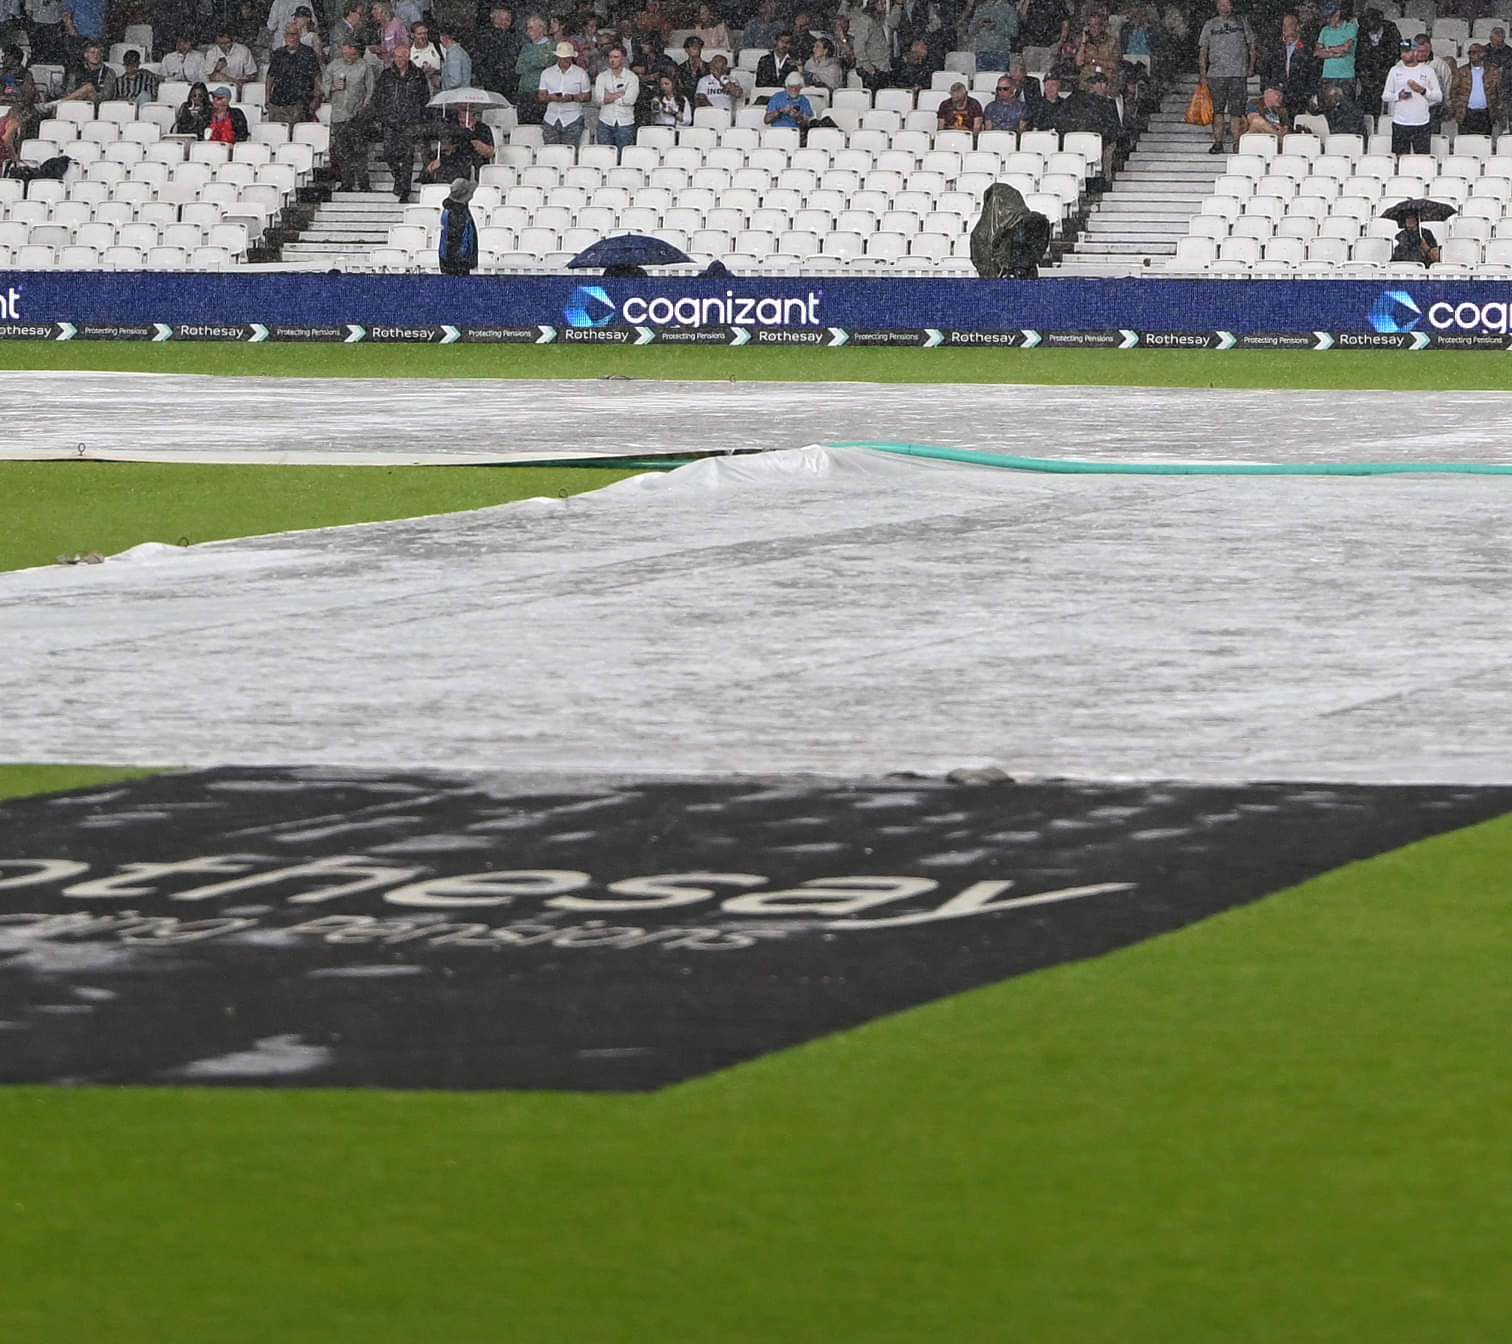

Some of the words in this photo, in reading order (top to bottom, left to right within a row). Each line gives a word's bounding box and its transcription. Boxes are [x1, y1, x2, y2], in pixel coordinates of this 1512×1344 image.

[623, 290, 820, 329] cognizant
[181, 326, 244, 338] Rothesay
[373, 328, 435, 340] Rothesay
[566, 329, 628, 342] Rothesay
[760, 331, 822, 343] Rothesay
[952, 332, 1015, 344] Rothesay
[1147, 334, 1210, 347] Rothesay
[1340, 334, 1404, 346] Rothesay
